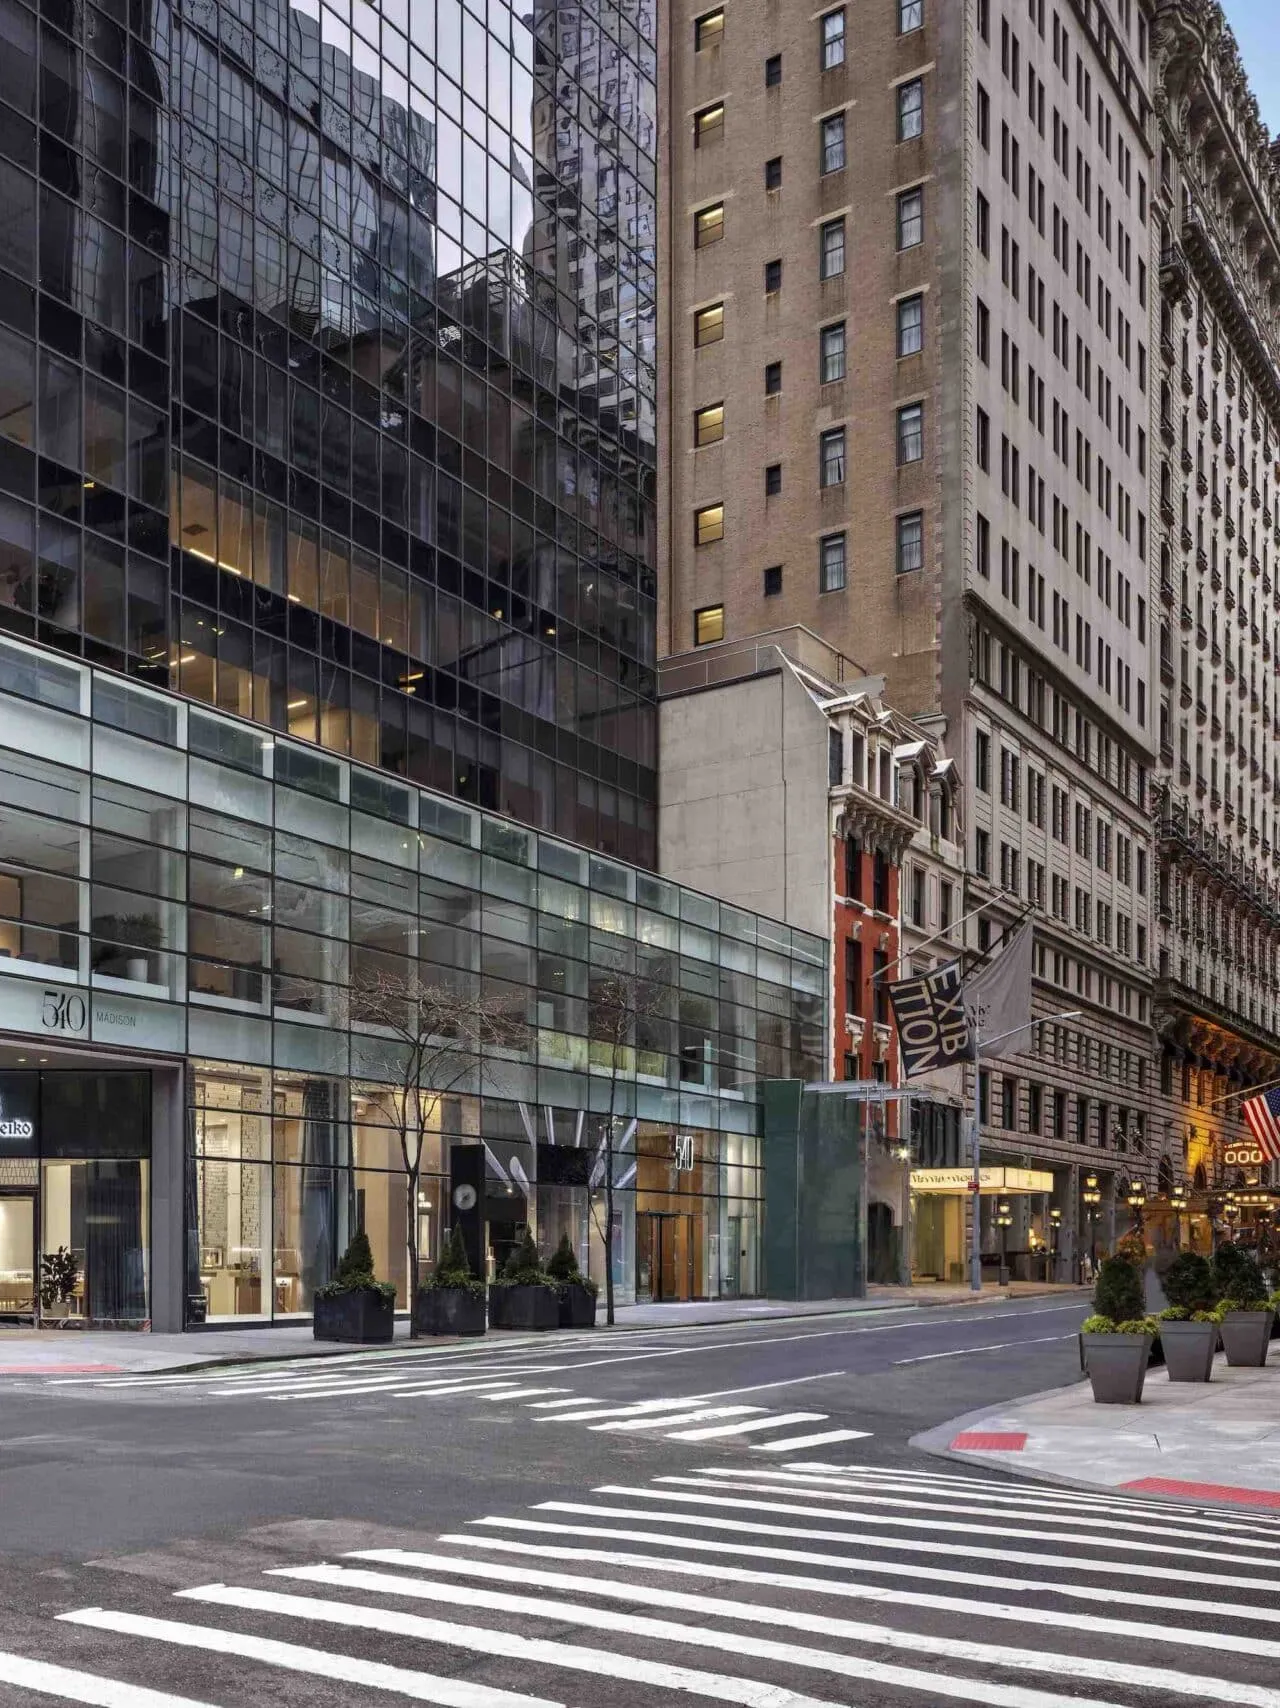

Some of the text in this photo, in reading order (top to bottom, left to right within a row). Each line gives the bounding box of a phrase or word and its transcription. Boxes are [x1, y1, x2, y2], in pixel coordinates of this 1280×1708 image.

[42, 990, 137, 1032] 540 MADISON
[675, 1134, 694, 1171] 540
